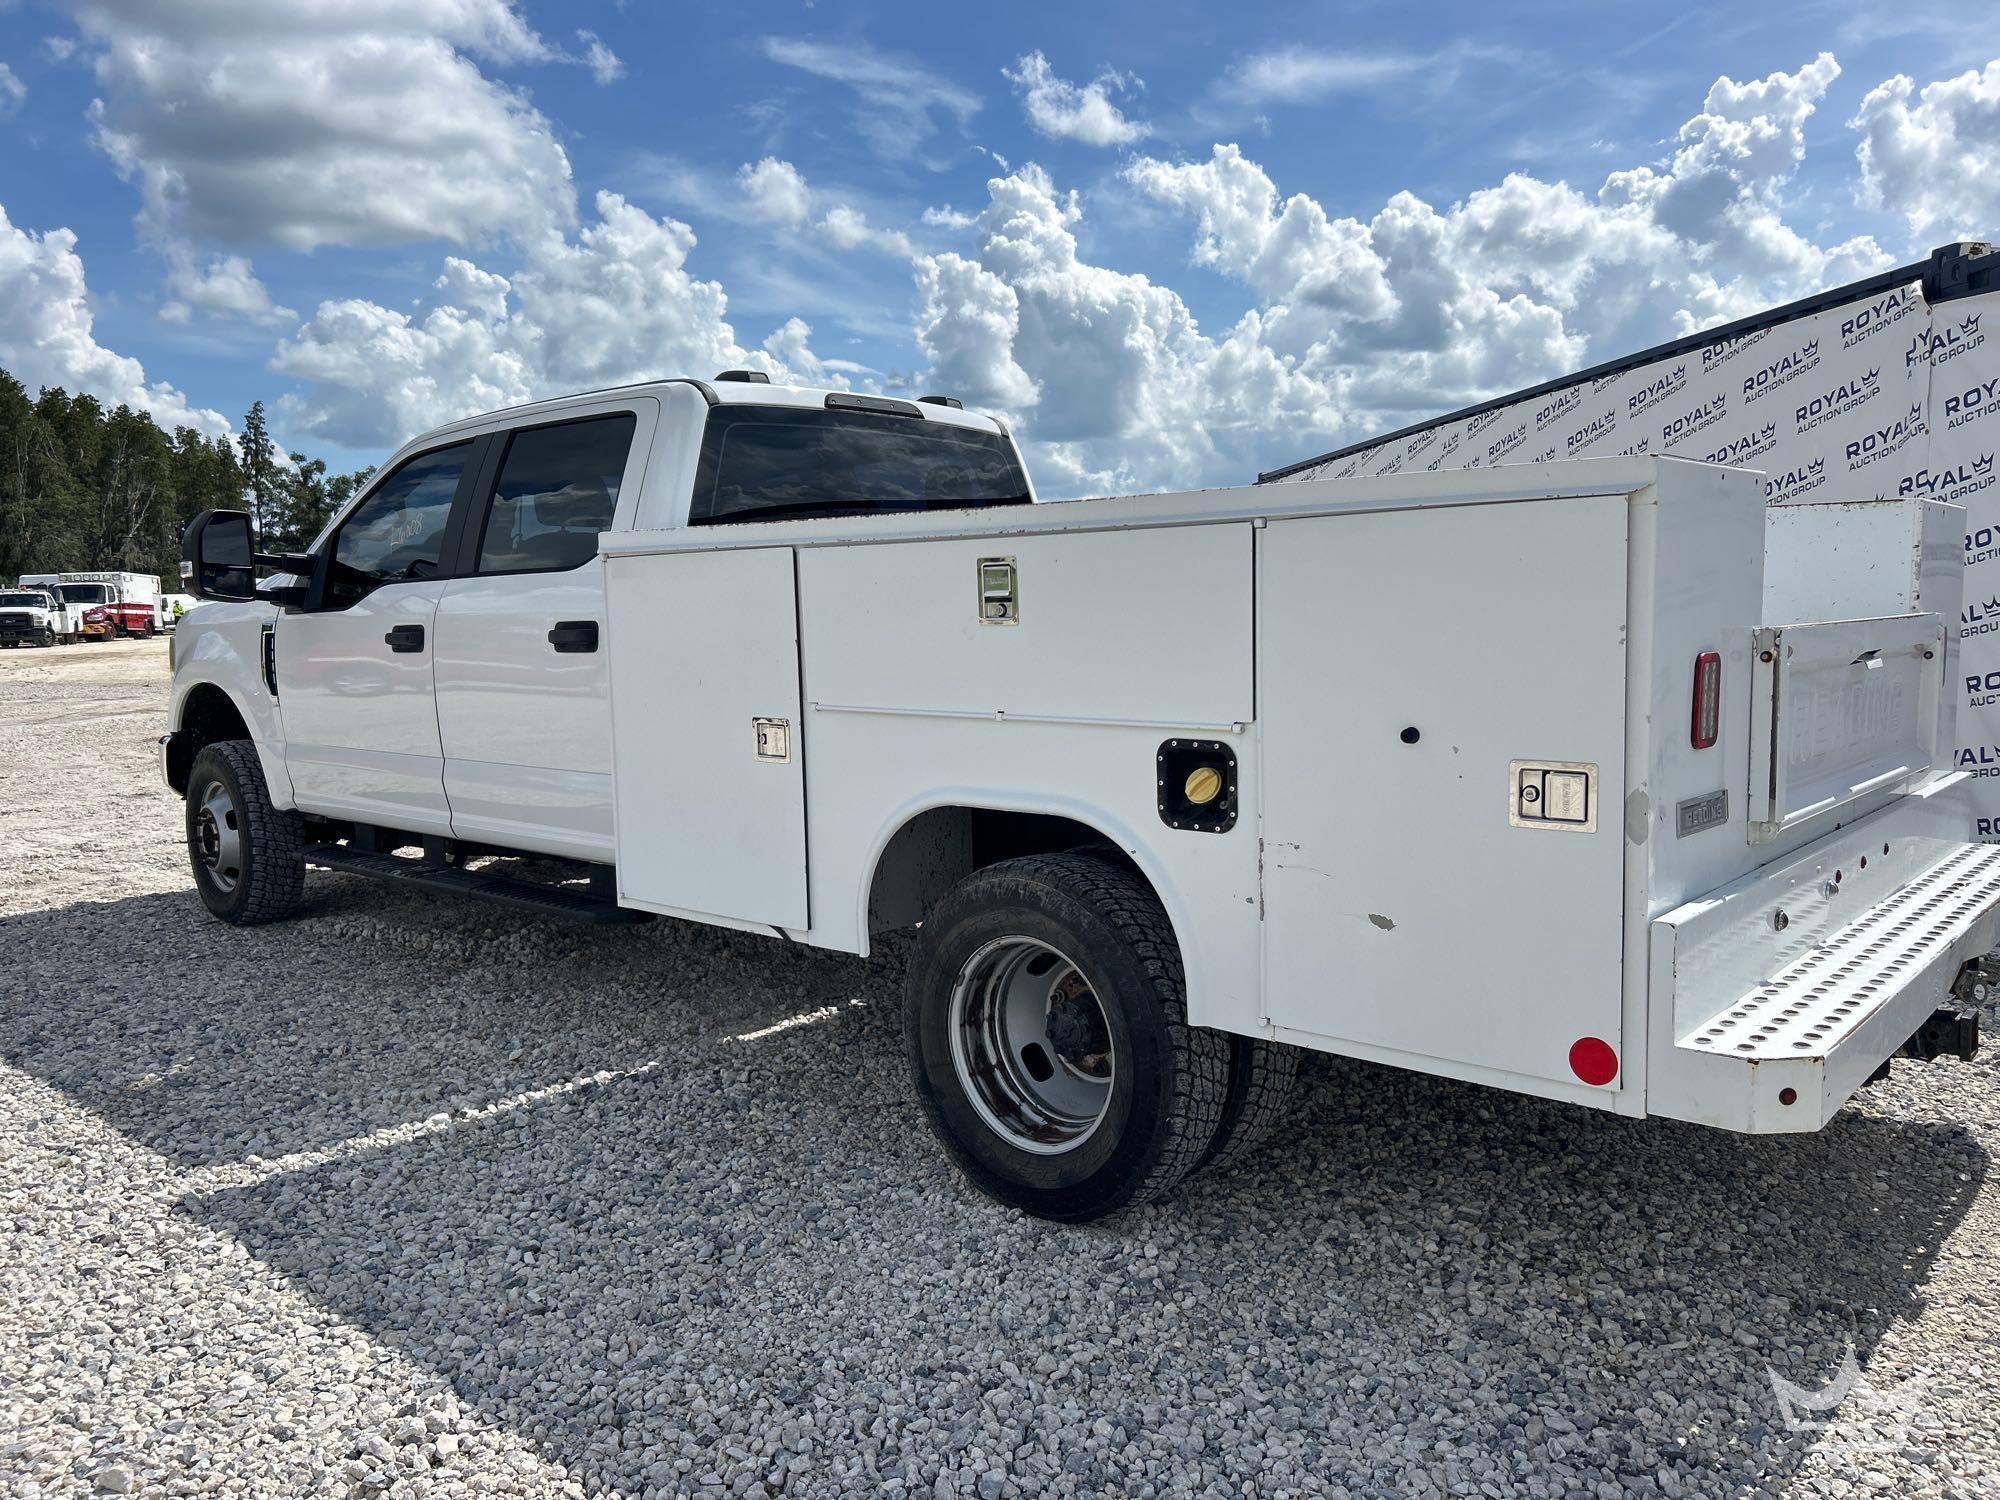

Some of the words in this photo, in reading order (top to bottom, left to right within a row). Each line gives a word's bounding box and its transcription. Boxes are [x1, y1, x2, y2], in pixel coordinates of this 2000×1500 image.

[1843, 317, 1892, 350] AUCTION
[1938, 334, 1985, 364] GROUP
[1703, 346, 1740, 375] AUCTION
[1741, 327, 1772, 351] GROUP
[1743, 351, 1803, 394] ROYAL
[1744, 376, 1785, 405] AUCTION
[1786, 357, 1821, 381] GROUP
[1628, 374, 1674, 410] ROYAL
[1629, 396, 1660, 420] AUCTION
[1660, 379, 1687, 401] GROUP
[1795, 380, 1862, 424] ROYAL
[1536, 394, 1570, 425] ROYAL
[1537, 411, 1561, 433] AUCTION
[1561, 398, 1581, 417] GROUP
[1662, 403, 1713, 440] ROYAL
[1797, 407, 1841, 435] AUCTION
[1843, 386, 1881, 412] GROUP
[1407, 431, 1431, 455] ROYAL
[1488, 431, 1518, 458] ROYAL
[1567, 416, 1605, 449] ROYAL
[1568, 435, 1594, 457] AUCTION
[1594, 423, 1616, 441] GROUP
[1664, 427, 1697, 450] AUCTION
[1697, 409, 1727, 432] GROUP
[1846, 416, 1909, 460] ROYAL
[1489, 447, 1510, 465] AUCTION
[1510, 435, 1527, 451] GROUP
[1745, 439, 1777, 461] GROUP
[1849, 443, 1897, 472] AUCTION
[1791, 475, 1826, 497] GROUP
[1950, 475, 1996, 500] GROUP
[1960, 621, 2000, 639] GROU
